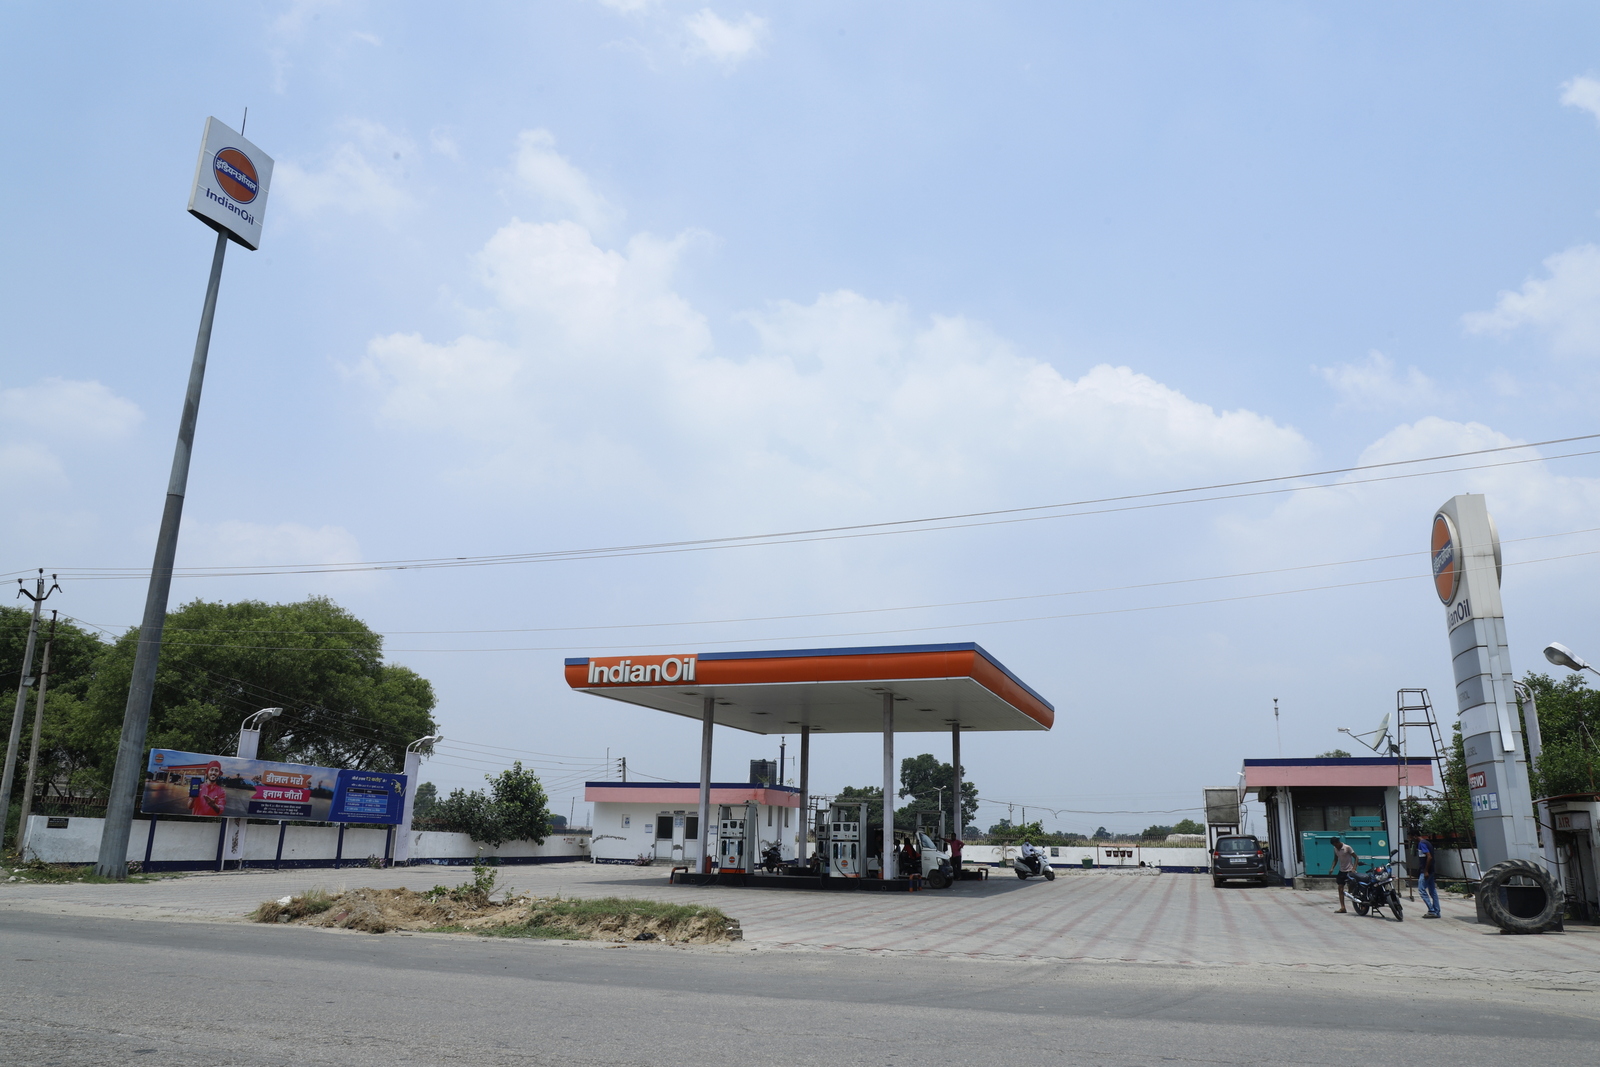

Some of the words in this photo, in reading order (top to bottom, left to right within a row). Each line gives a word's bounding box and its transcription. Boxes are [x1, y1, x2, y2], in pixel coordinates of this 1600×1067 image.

[205, 188, 255, 225] IndianOil
[587, 657, 696, 684] IndianOil
[266, 772, 289, 784] डीज़ल
[290, 774, 304, 785] भरो
[262, 789, 283, 799] इनाम
[284, 789, 304, 800] जीतो
[1558, 816, 1570, 828] AIR
